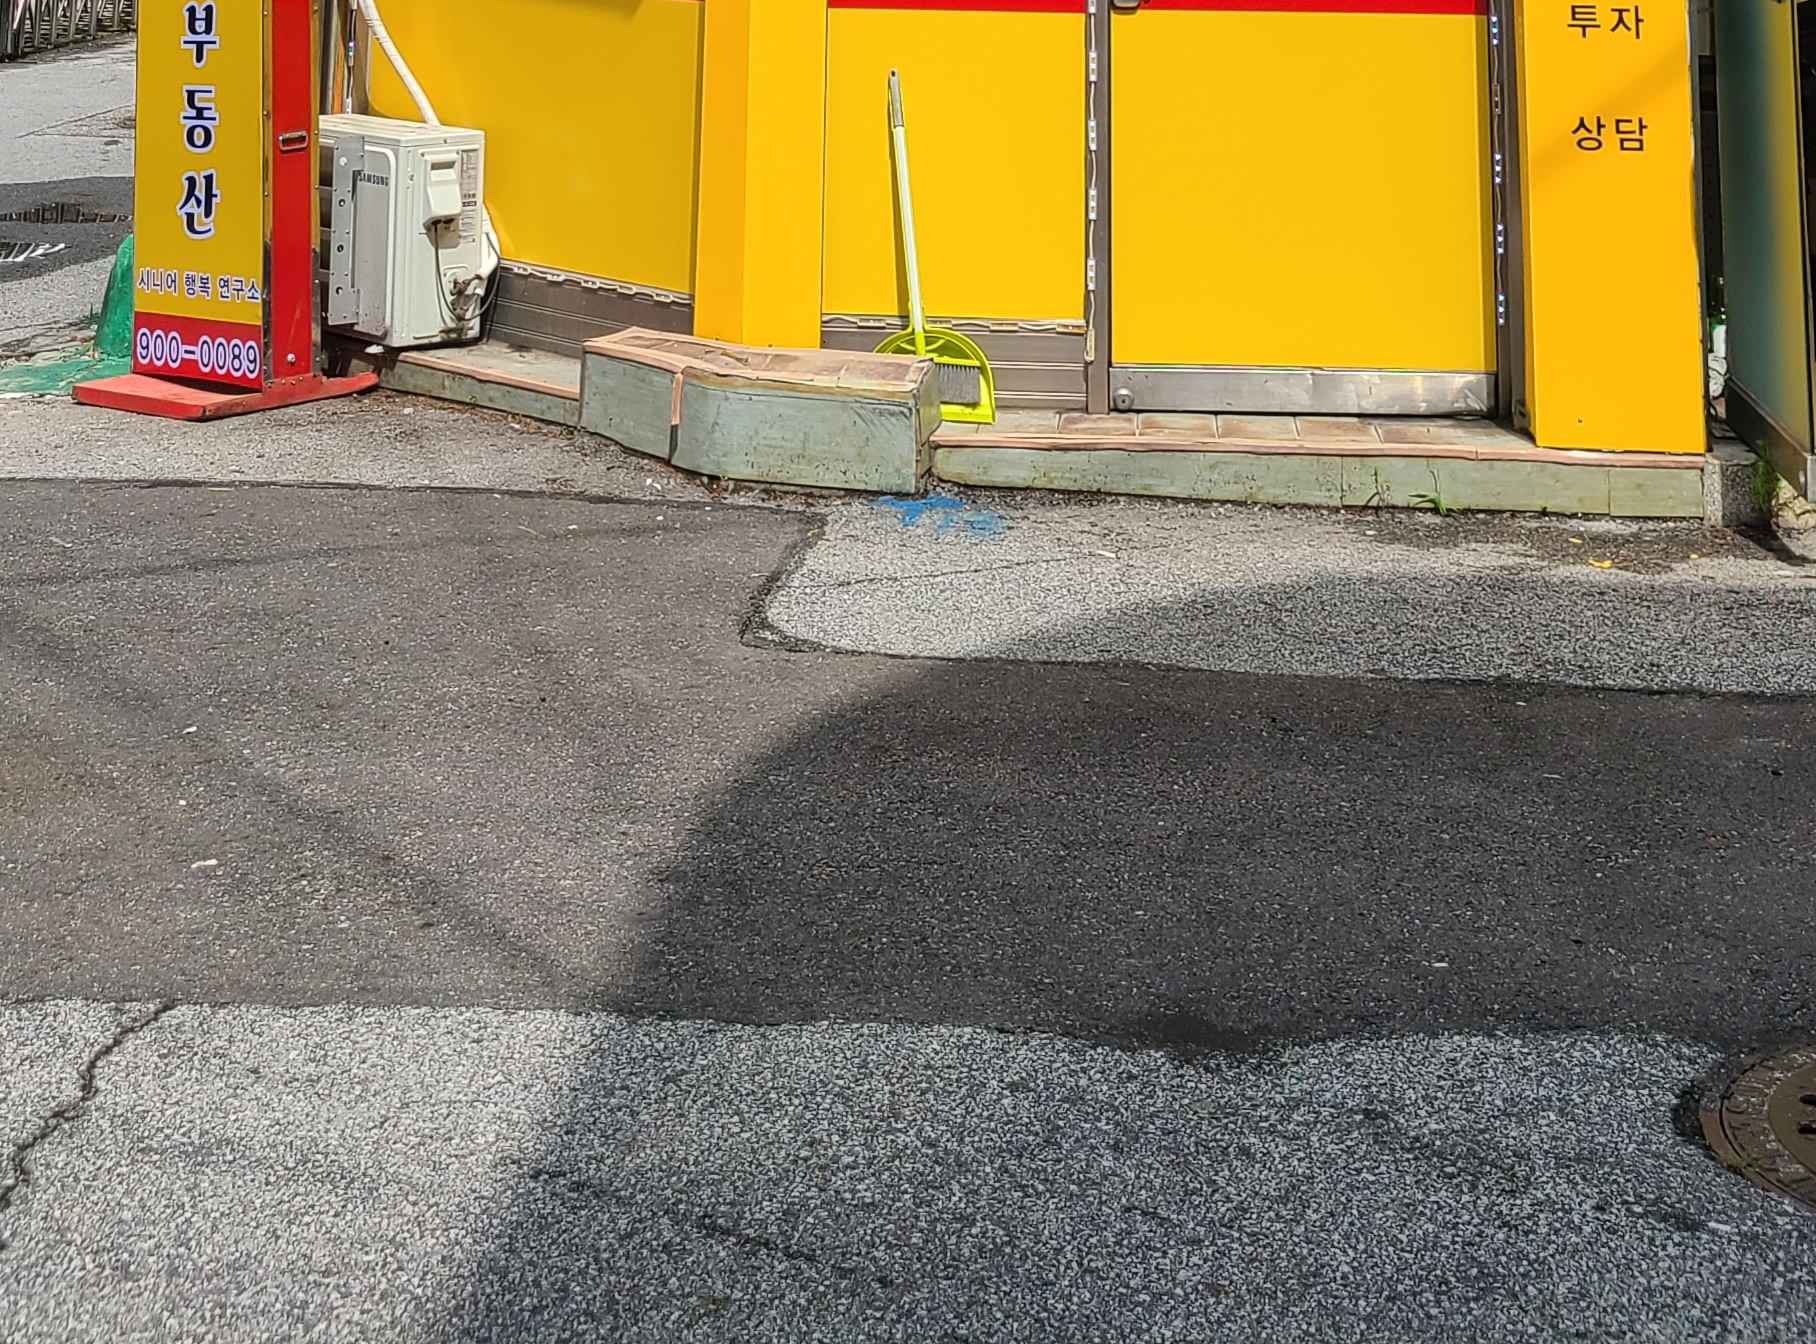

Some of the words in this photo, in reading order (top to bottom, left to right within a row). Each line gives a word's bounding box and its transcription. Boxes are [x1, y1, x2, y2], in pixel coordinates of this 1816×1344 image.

[1566, 4, 1645, 39] 투자
[1570, 115, 1648, 152] 상담
[358, 169, 389, 187] SAMSUNG
[138, 267, 179, 296] 시니어
[184, 270, 212, 300] 행복
[218, 273, 260, 304] 연구소
[136, 326, 261, 380] 900-0089
